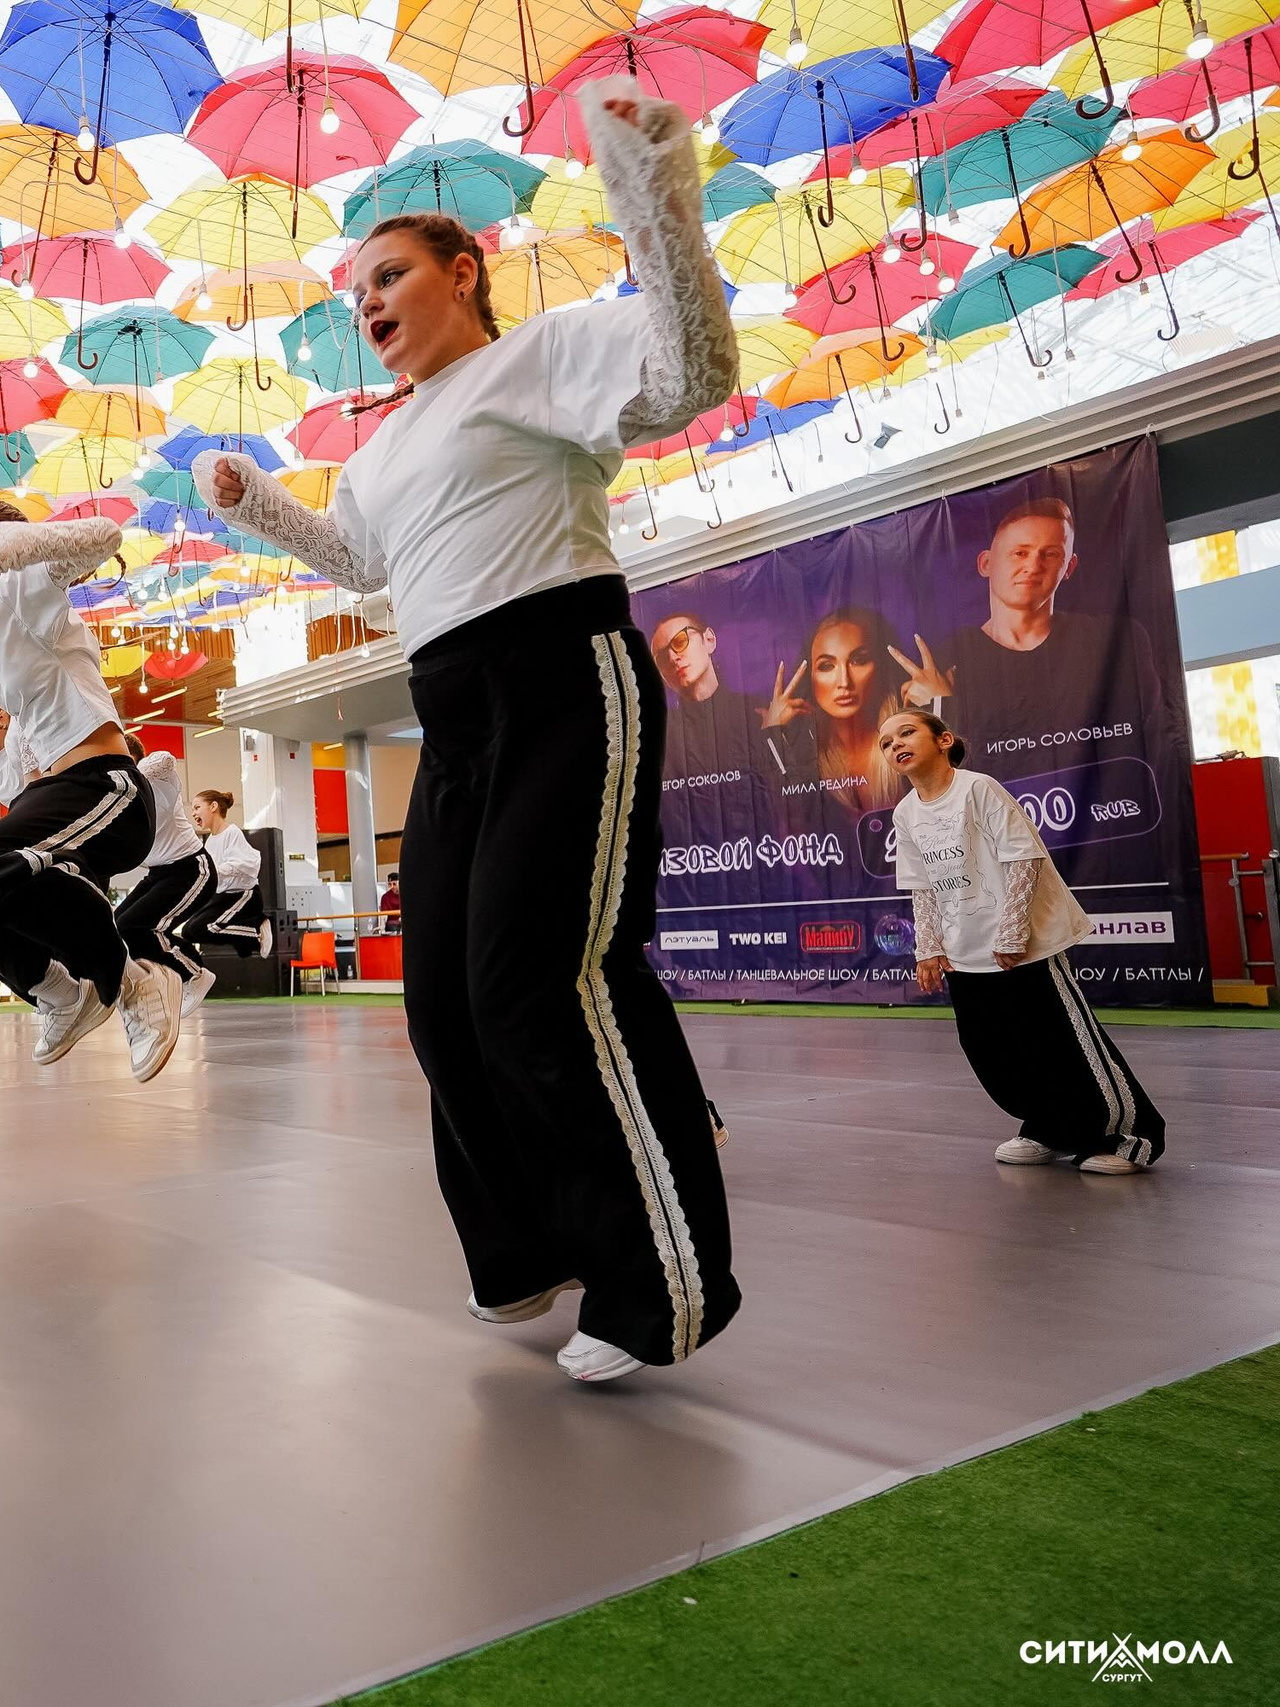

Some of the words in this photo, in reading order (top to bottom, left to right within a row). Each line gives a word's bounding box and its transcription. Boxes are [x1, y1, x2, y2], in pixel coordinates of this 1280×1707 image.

[987, 738, 1036, 754] ИГОРЬ
[1041, 723, 1133, 747] СОЛОВЬЕВ
[662, 778, 686, 791] ЕГОР
[687, 770, 741, 787] СОКОЛОВ
[781, 782, 816, 796] МИЛА
[819, 775, 868, 791] РЕДИНА
[1091, 800, 1141, 822] RUB
[922, 845, 965, 865] RINCESS
[931, 875, 972, 893] STORIES
[729, 932, 761, 946] TWO
[764, 931, 787, 945] KEI
[687, 969, 726, 981] БАТТЛЫ
[736, 968, 825, 983] ТАНЦЕВАЛЬНОЕ
[828, 968, 859, 981] ШОУ
[1125, 967, 1192, 981] БАТТЛЫ
